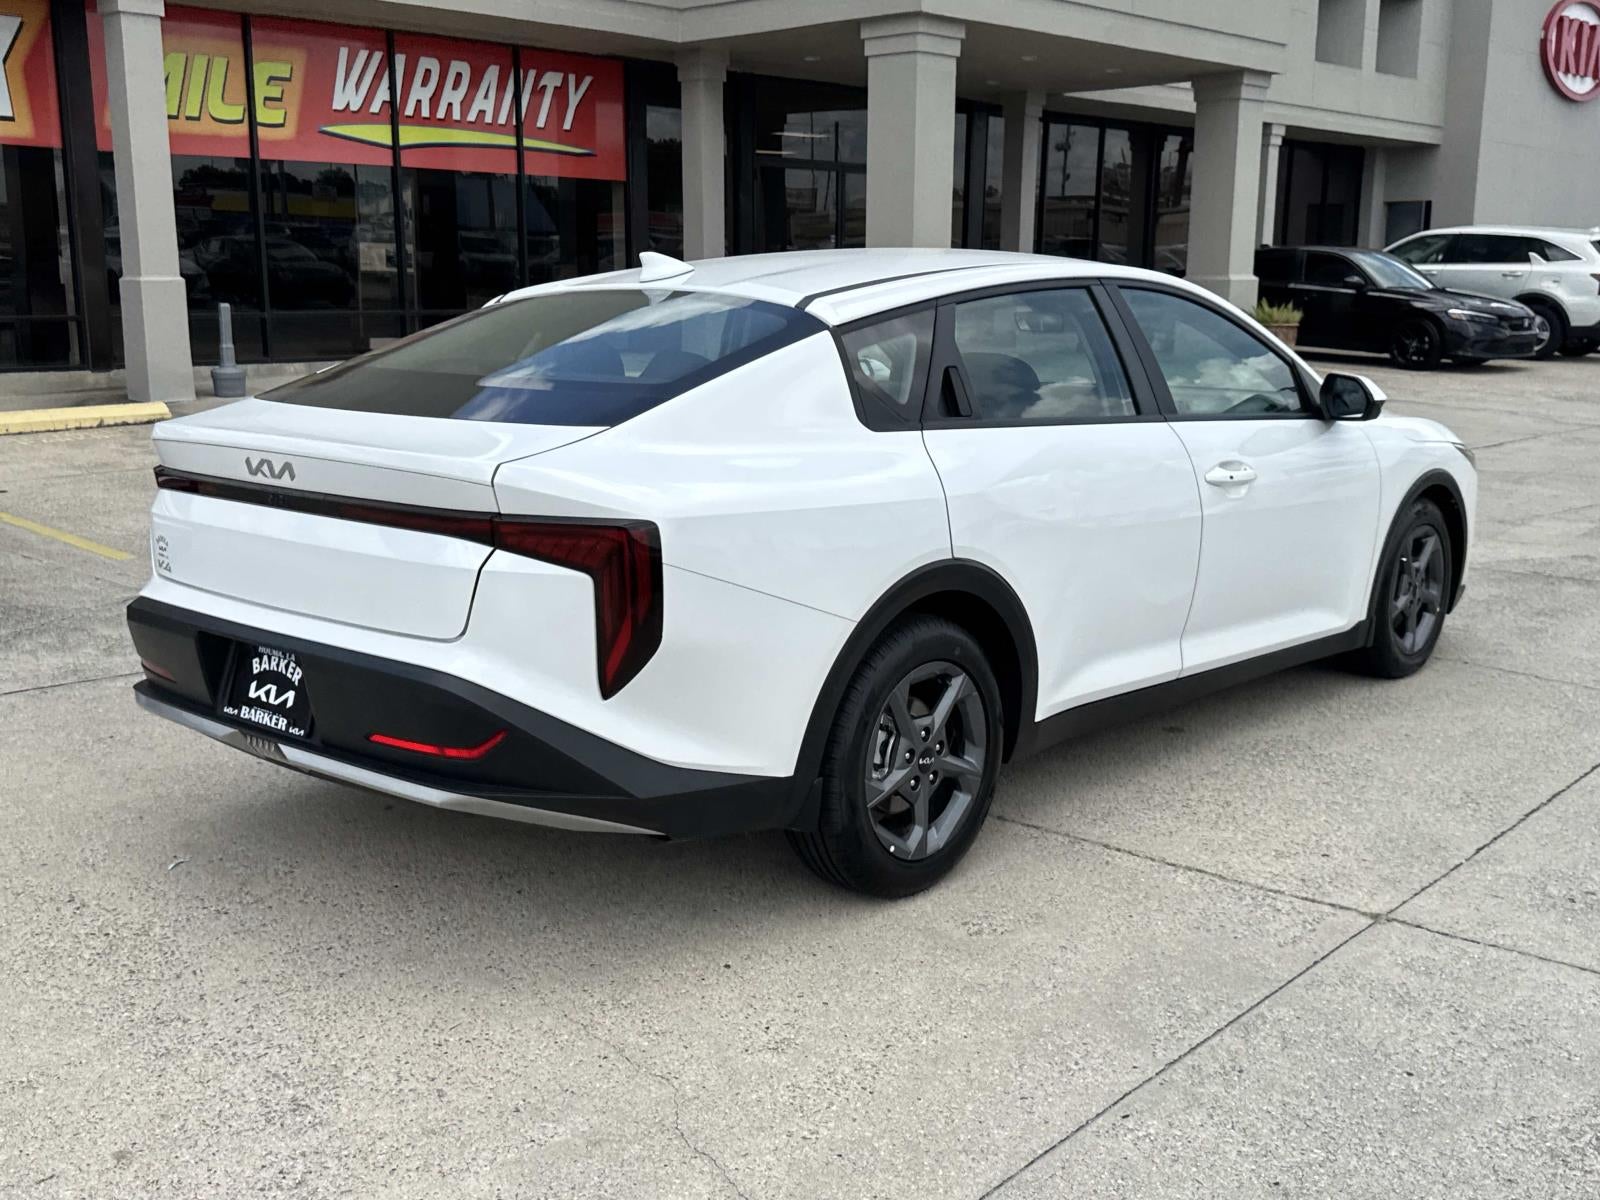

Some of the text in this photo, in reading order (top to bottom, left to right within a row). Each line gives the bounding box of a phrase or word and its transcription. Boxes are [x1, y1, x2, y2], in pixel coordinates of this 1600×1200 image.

[332, 46, 594, 132] WARRANTY
[245, 456, 296, 482] KIA
[252, 654, 303, 687] BARKER
[248, 680, 296, 709] KIA
[240, 705, 288, 732] BARKER
